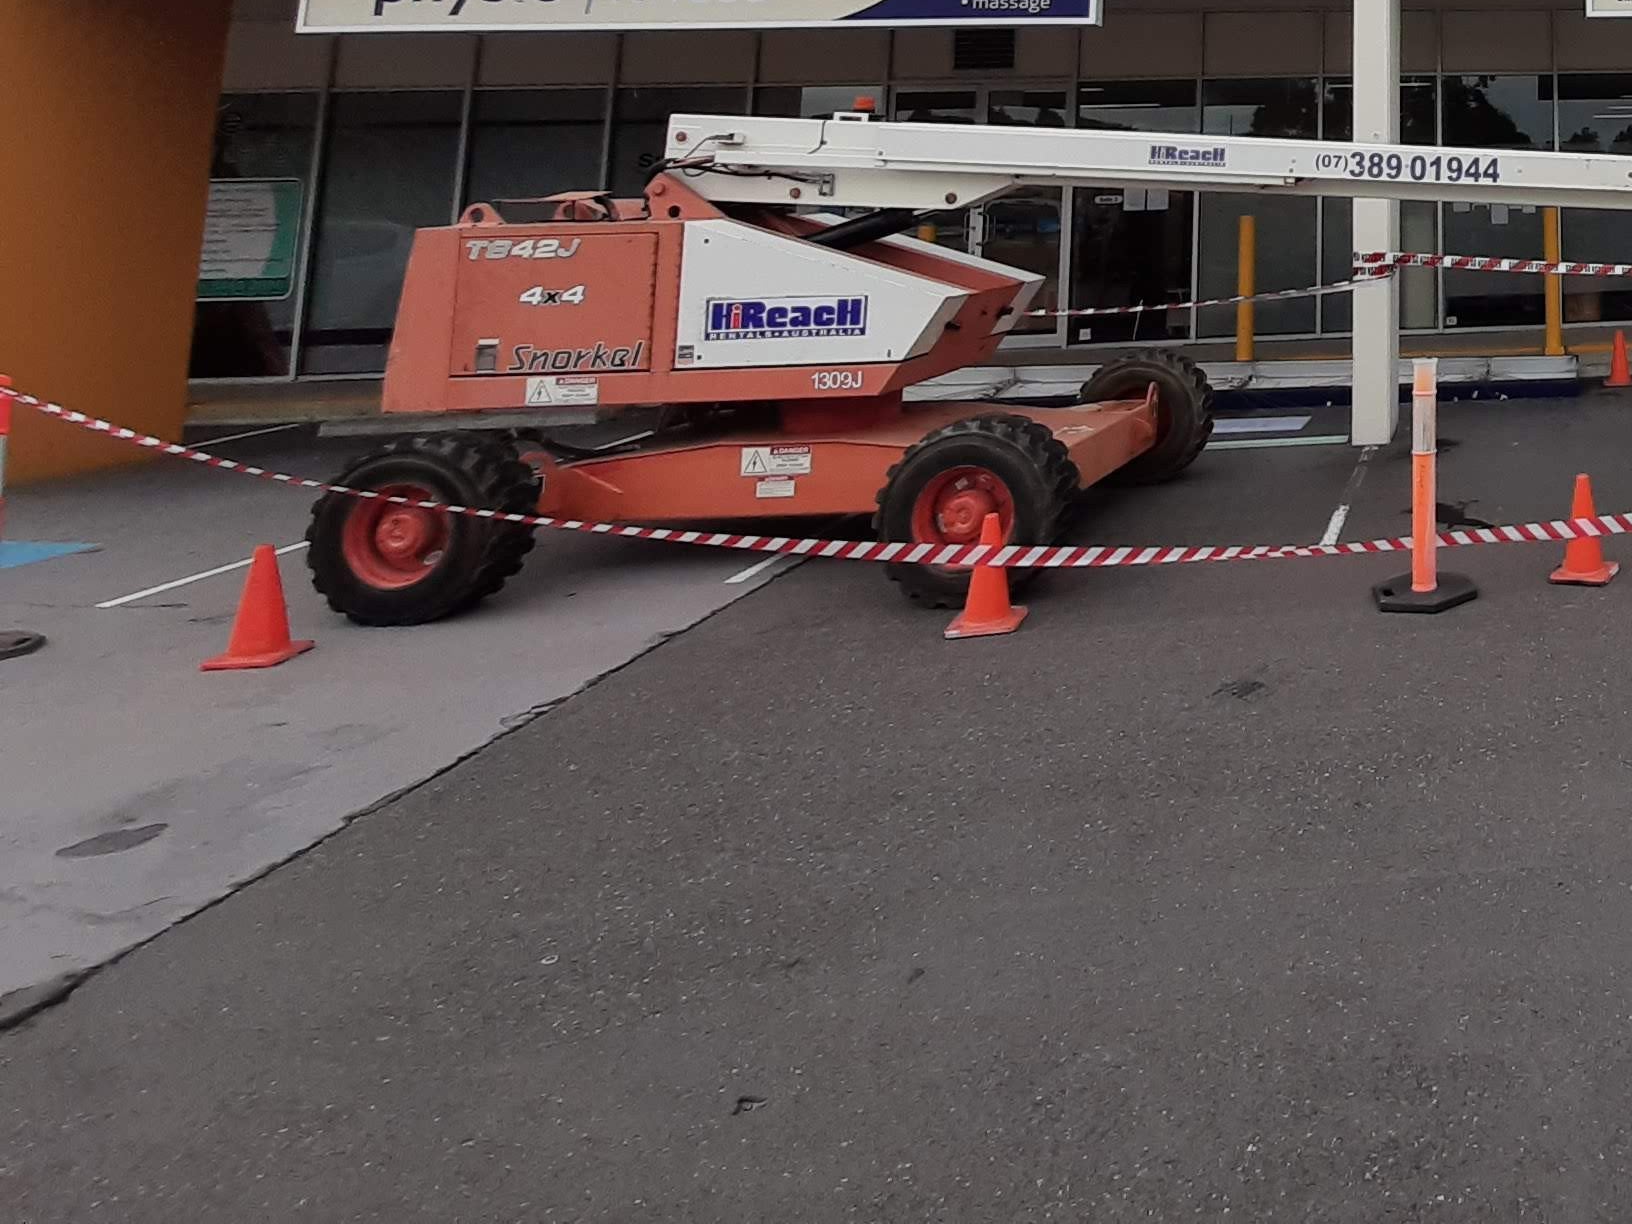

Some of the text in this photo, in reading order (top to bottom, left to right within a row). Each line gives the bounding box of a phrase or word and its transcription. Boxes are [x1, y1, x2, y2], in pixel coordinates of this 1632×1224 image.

[519, 285, 586, 305] 4x4
[508, 339, 645, 371] Snorkel
[811, 371, 863, 390] 1309J
